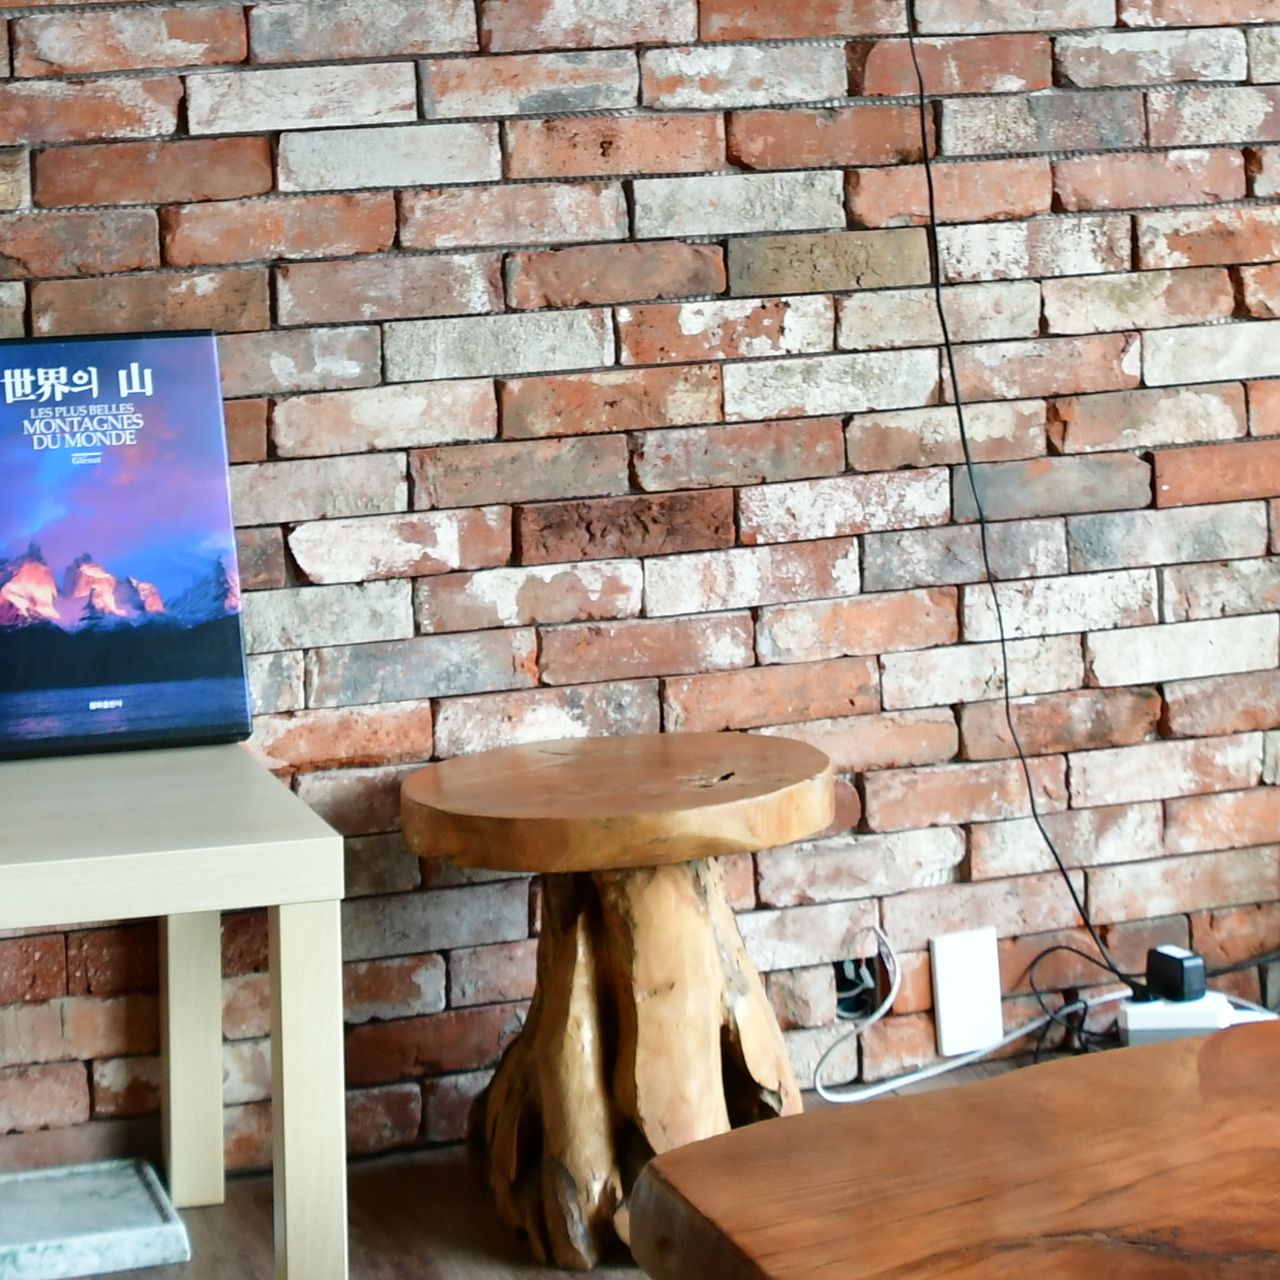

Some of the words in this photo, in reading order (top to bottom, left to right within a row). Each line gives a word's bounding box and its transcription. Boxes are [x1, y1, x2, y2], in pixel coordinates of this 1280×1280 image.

[0, 366, 99, 404] 世界의
[118, 362, 154, 398] 山
[29, 406, 54, 419] LES
[55, 404, 88, 418] PLUS
[89, 402, 135, 415] BELLES
[22, 413, 145, 435] MONTAGNES
[32, 433, 62, 450] DU
[64, 429, 137, 449] MONDE
